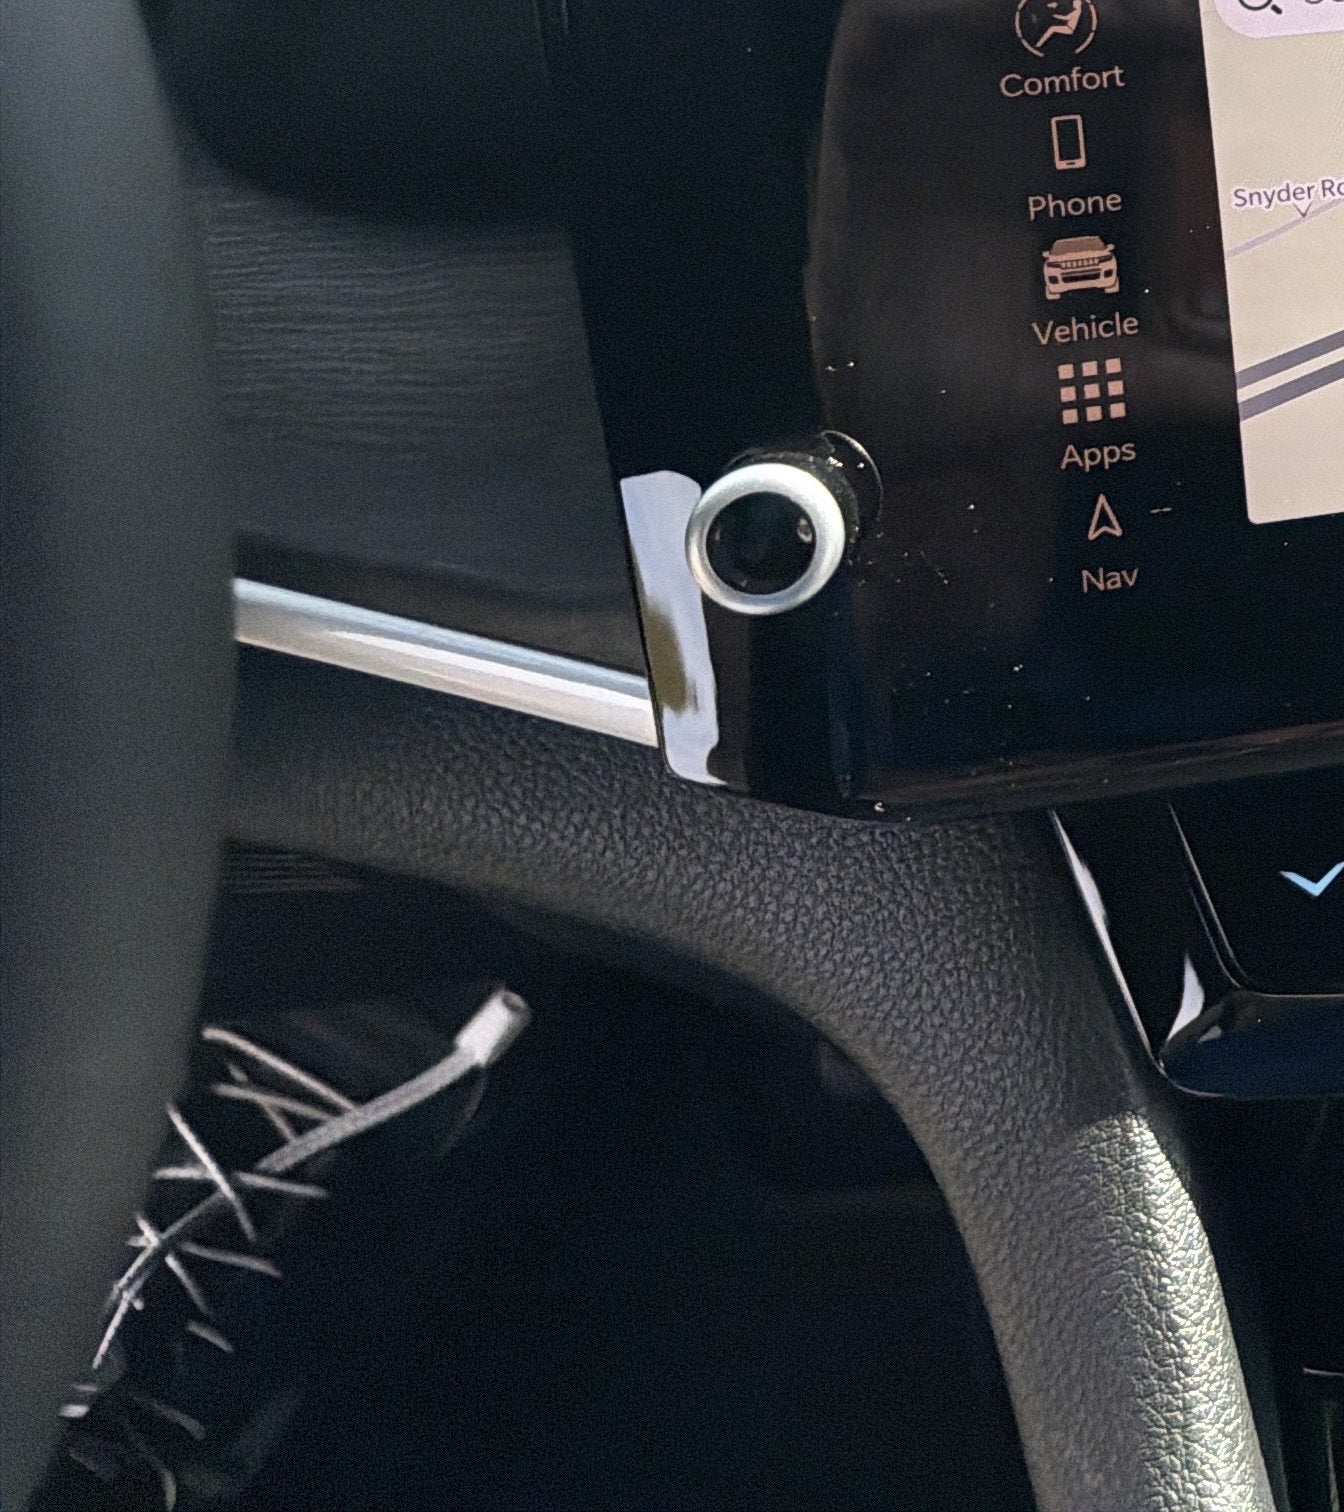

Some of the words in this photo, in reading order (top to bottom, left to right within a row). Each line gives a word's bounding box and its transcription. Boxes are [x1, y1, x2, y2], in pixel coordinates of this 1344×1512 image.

[1000, 64, 1125, 97] Comfort
[1027, 192, 1122, 221] Phone
[1232, 182, 1316, 210] Snyder
[1032, 312, 1139, 346] Vehicle
[1060, 441, 1137, 473] Apps
[1081, 568, 1139, 594] Nav
